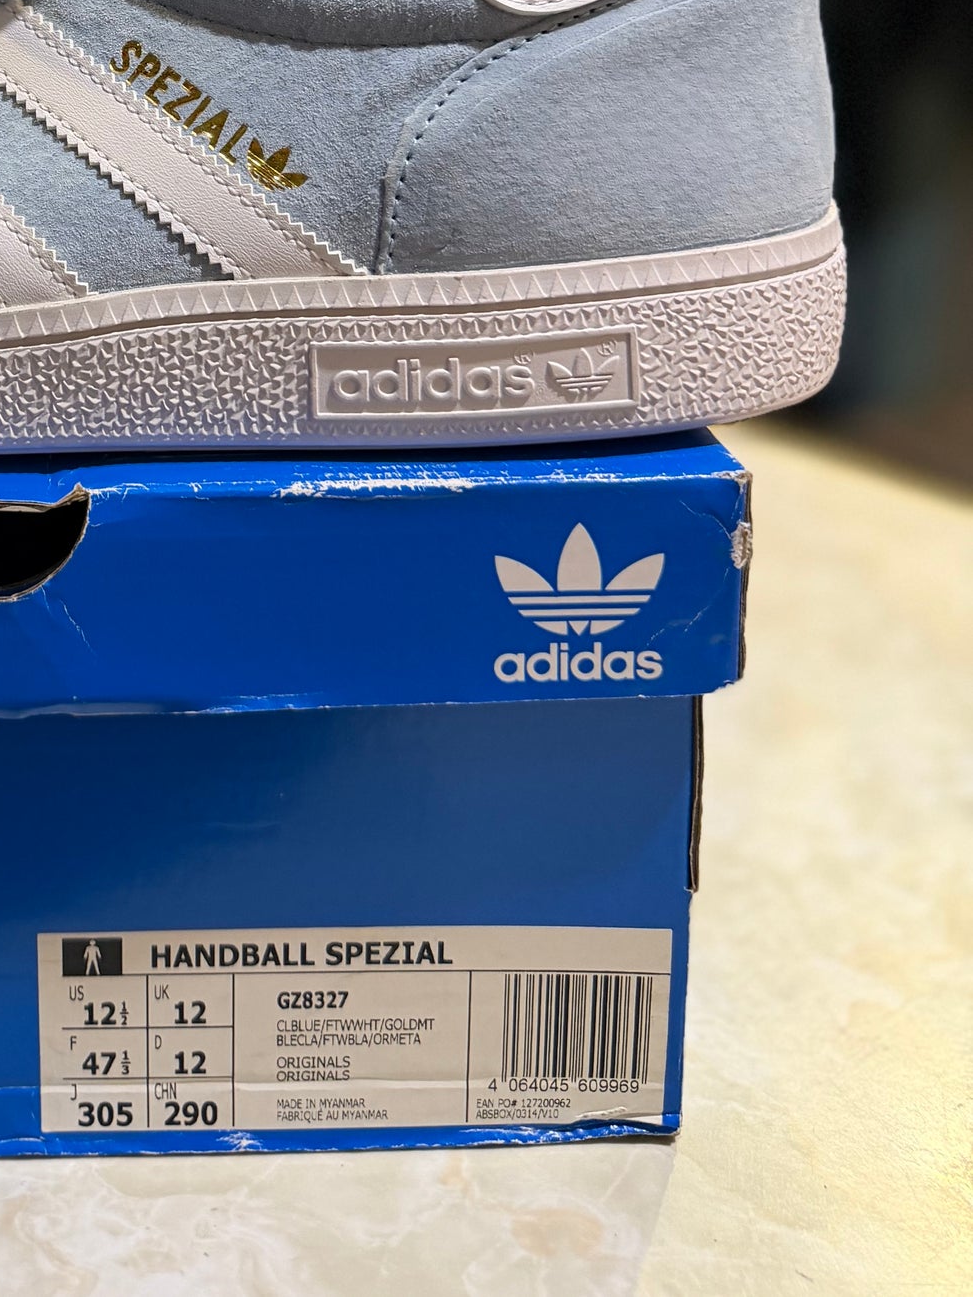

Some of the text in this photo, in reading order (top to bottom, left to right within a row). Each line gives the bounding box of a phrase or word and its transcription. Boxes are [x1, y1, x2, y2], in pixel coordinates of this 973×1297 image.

[109, 40, 249, 166] SPEZIAL
[493, 641, 664, 684] adidas
[150, 941, 454, 969] HANDBALL SPEZIAL
[69, 985, 85, 1001] US
[154, 984, 170, 1000] UK
[276, 990, 349, 1010] GZ8327
[174, 1001, 207, 1025] 12
[276, 1018, 436, 1033] CLBLUE/FTWWHT/GOLDMT
[70, 1035, 77, 1051] F
[154, 1035, 162, 1050] D
[276, 1033, 421, 1048] BLECLA/FTWBLA/ORMETA
[174, 1051, 207, 1075] 12
[276, 1055, 351, 1069] ORIGINALS
[276, 1069, 351, 1082] ORIGINALS
[70, 1083, 77, 1101] J
[154, 1082, 177, 1100] CHN
[488, 1078, 640, 1093] 4 064045 609969
[276, 1098, 366, 1109] MADE IN MYANMAR
[476, 1098, 571, 1109] EAN PO# 127200962
[78, 1102, 133, 1127] 305
[164, 1101, 218, 1126] 290
[326, 1110, 339, 1121] AU
[341, 1109, 389, 1121] MYANMAR
